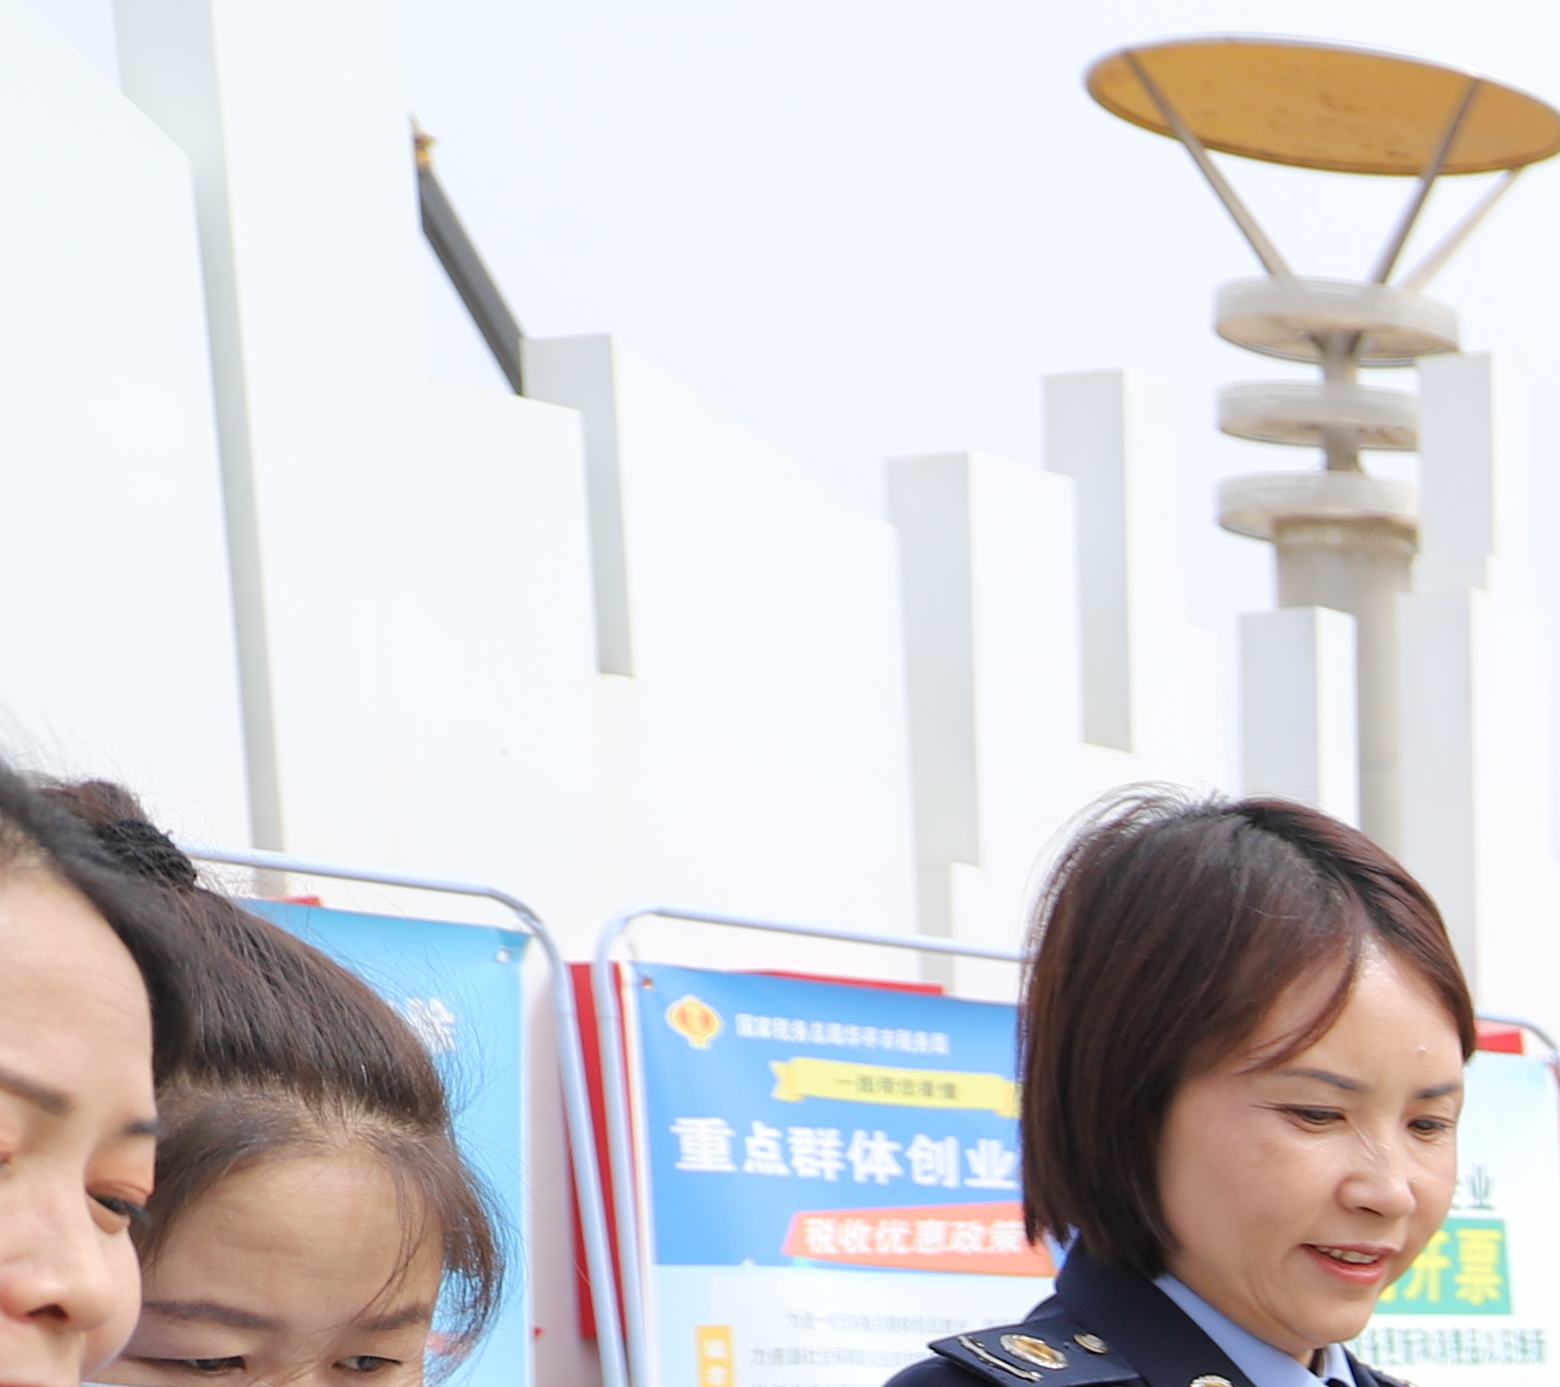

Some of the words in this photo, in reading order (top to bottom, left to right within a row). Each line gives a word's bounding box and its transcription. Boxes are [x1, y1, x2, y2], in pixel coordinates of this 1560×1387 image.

[669, 1116, 1021, 1190] 重点群体创业
[1377, 1227, 1503, 1305] 开票
